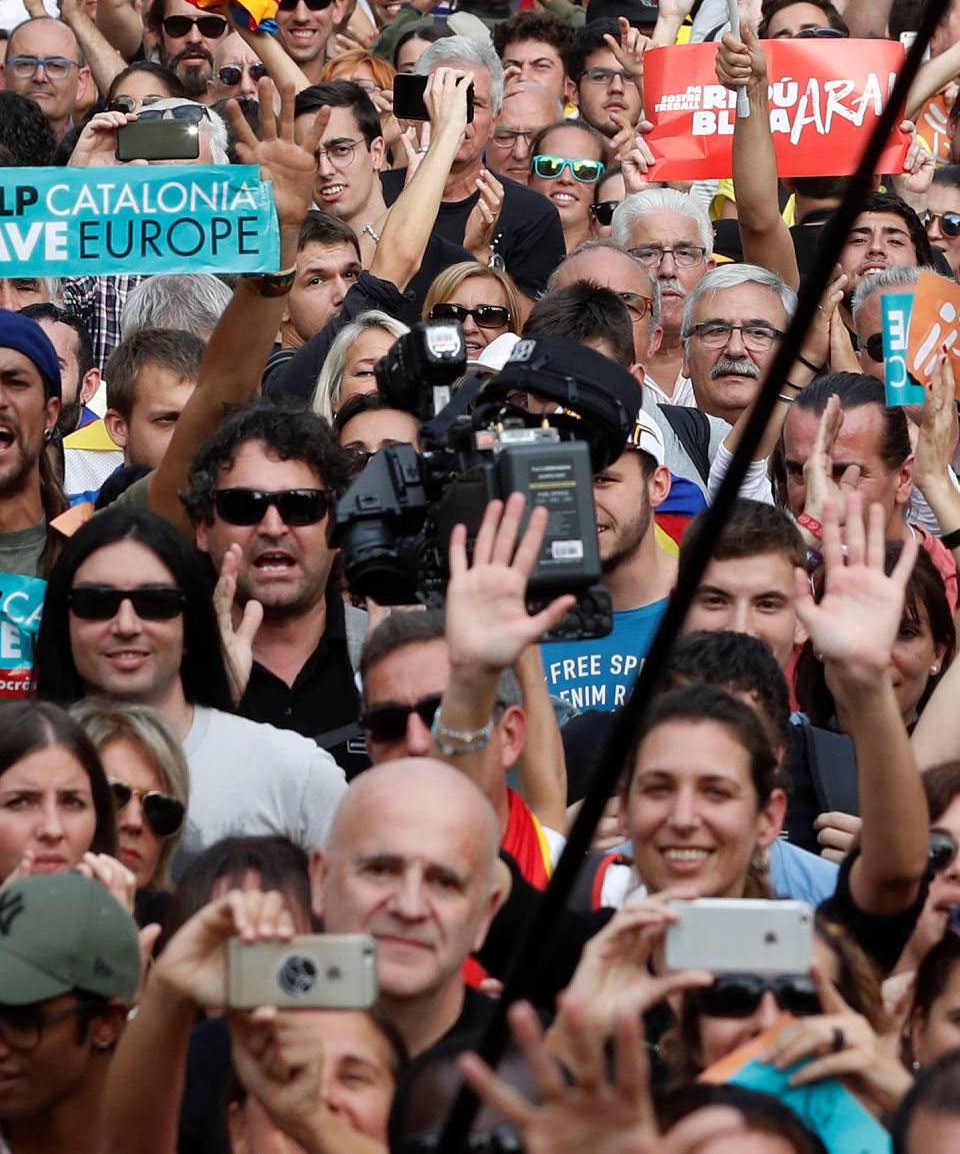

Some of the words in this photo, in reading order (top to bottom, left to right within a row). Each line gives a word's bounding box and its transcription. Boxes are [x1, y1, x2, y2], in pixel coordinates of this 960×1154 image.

[692, 109, 792, 136] BLA
[46, 182, 259, 216] CATALONIA
[79, 215, 260, 259] EUROPE
[550, 654, 602, 684] FREE
